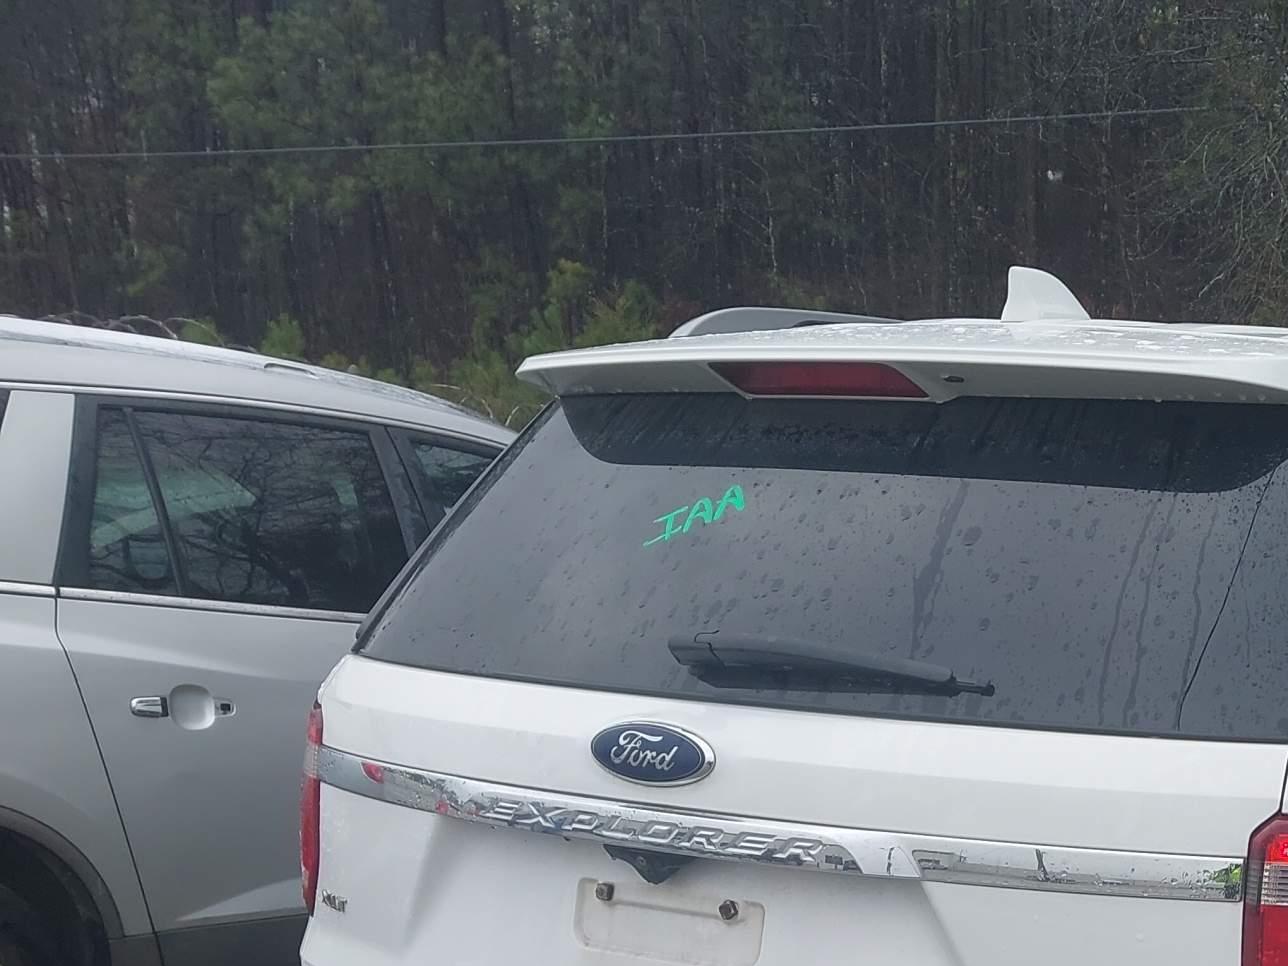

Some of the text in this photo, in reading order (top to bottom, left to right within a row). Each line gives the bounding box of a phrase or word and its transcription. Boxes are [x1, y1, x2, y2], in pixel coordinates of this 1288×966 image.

[643, 484, 745, 547] IAA
[610, 730, 679, 771] Ford
[480, 799, 825, 863] EXPLORER
